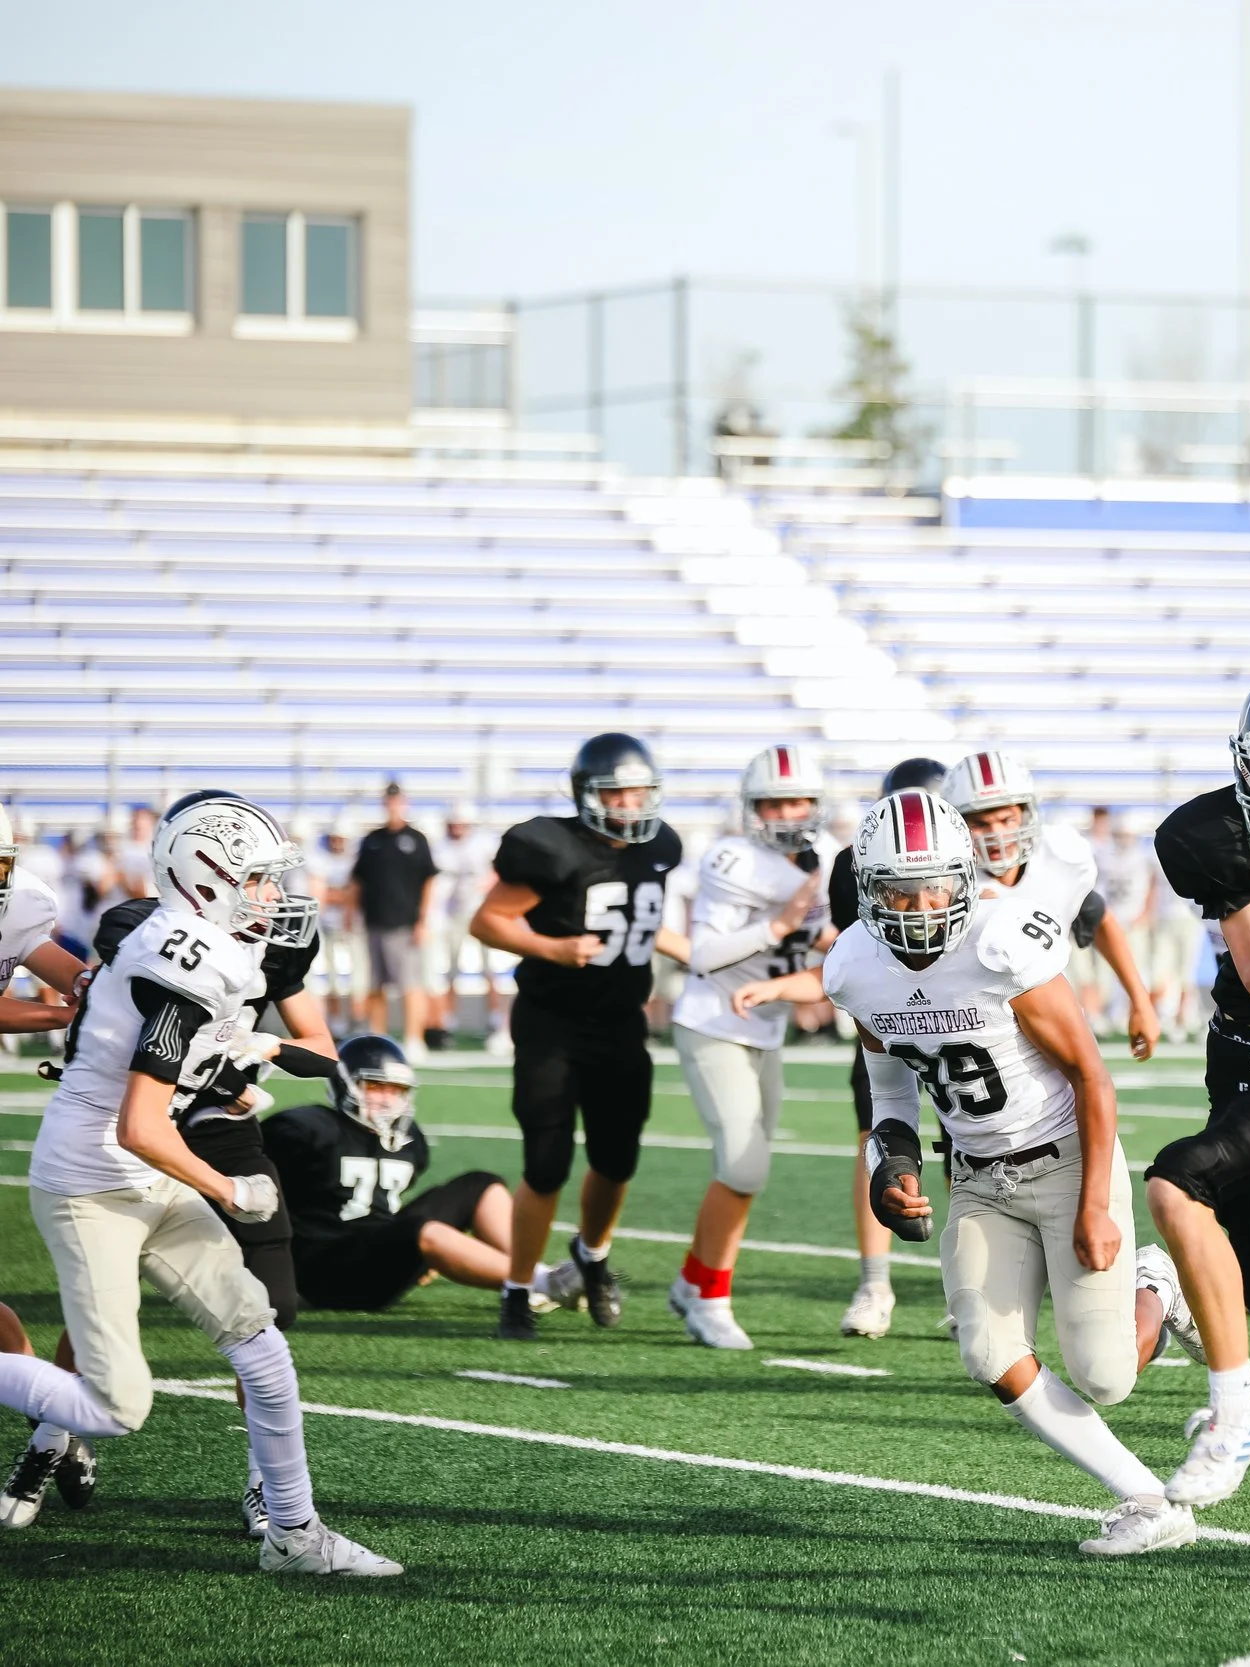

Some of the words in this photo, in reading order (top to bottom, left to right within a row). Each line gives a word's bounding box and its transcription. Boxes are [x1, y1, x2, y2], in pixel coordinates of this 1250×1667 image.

[711, 850, 741, 876] 51
[906, 854, 932, 863] Riddell
[584, 881, 664, 967] 58
[1021, 910, 1062, 951] 99
[158, 928, 211, 973] 25
[906, 998, 932, 1007] adidas
[870, 1007, 986, 1036] CENTENNIAL
[339, 1155, 416, 1222] 77
